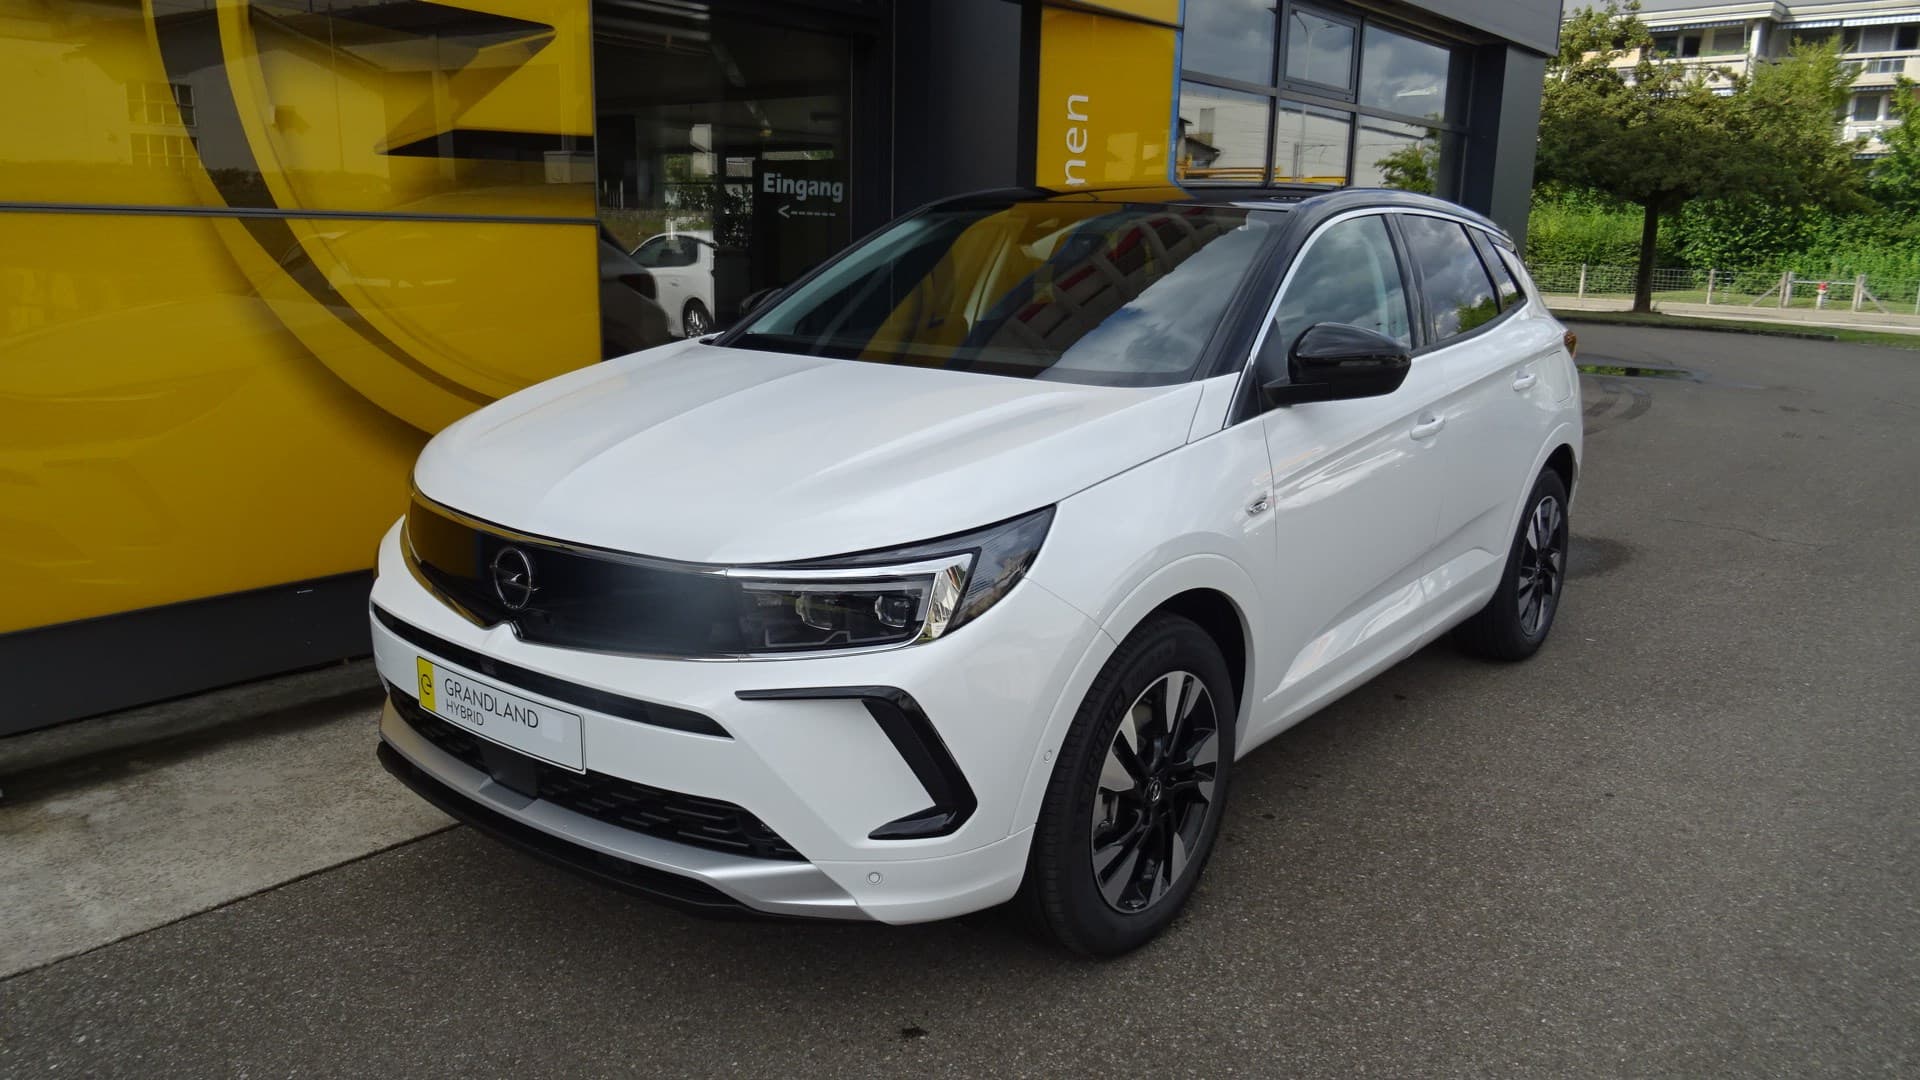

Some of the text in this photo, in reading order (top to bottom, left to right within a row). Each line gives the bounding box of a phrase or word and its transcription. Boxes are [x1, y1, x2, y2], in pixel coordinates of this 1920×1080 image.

[763, 172, 843, 203] Eingang
[444, 678, 539, 728] GRANDLAND
[446, 698, 485, 726] HYBRID
